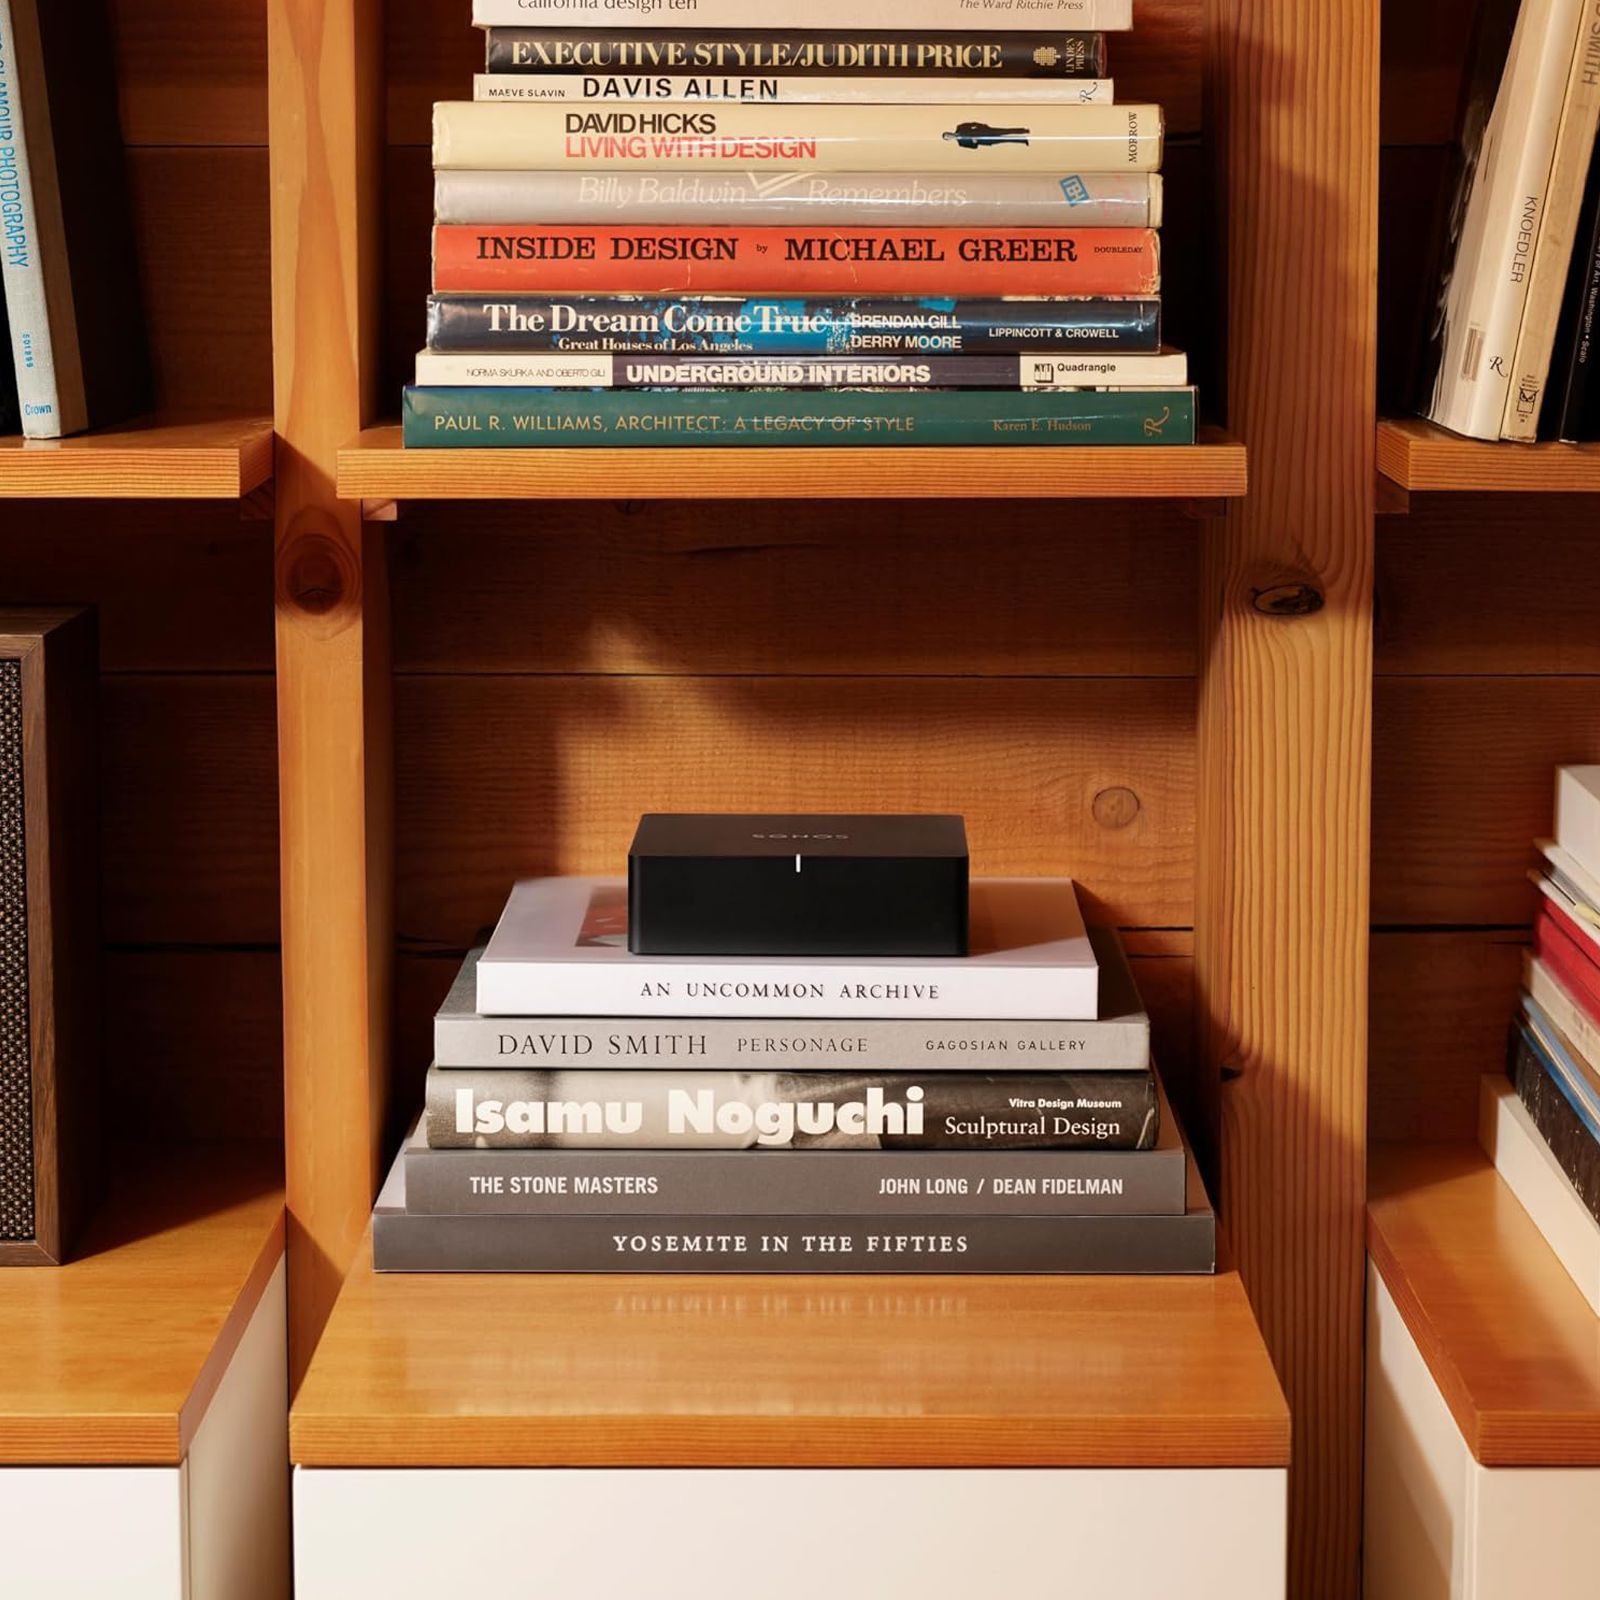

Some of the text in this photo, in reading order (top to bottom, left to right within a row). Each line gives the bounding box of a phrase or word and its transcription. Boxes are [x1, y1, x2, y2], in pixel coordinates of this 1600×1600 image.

[518, 0, 698, 13] california design ten
[960, 0, 1084, 10] The Ward Ritchie Press
[511, 41, 687, 67] EXECUTIVE
[917, 44, 1003, 69] PRICE
[1066, 38, 1075, 73] LINDEN
[1076, 40, 1085, 70] PRESS
[488, 77, 778, 100] MAEVE SLAVIN DAVIS ALLEN
[565, 113, 717, 135] DAVID HICKS
[1128, 112, 1138, 164] MORROW
[565, 136, 817, 159] LIVING WITH DESIGN
[0, 59, 29, 267] MOUR PHOTOGRAPHY
[578, 176, 968, 209] Billy Baldwin Remembers
[1510, 195, 1539, 284] KNOEDLER
[477, 237, 1078, 262] INSIDE DESIGN by MICHAEL GREER
[1093, 246, 1144, 254] DOUBLEDAY
[483, 303, 828, 334] The Dream Come True
[1584, 286, 1599, 334] Washington
[851, 315, 962, 329] BRENDAN GILL
[851, 335, 962, 349] DERRY MOORE
[989, 328, 1120, 339] LIPPINCOTT & CROWELL
[558, 337, 754, 353] Great Houses of Los Angeles
[466, 368, 498, 378] NORMA
[499, 368, 534, 378] SKURKA
[536, 368, 554, 378] AND
[555, 368, 589, 378] OBERTO
[626, 364, 931, 383] UNDERGROUND INTERIORS
[1057, 363, 1116, 374] Quadrangle
[25, 404, 52, 416] Crown
[434, 415, 915, 433] PAUL R. WILLIAMS, ARCHITECT: A LEGACY OF STYLE
[992, 418, 1092, 432] Karen E. Hudson
[640, 982, 940, 999] AN UNCOMMON ARCHIVE
[498, 1035, 1087, 1055] DAVID SMITH PERSONAGE GAGOSIAN GALLERY
[1008, 1098, 1122, 1110] Vitra Design Museum
[455, 1086, 925, 1146] Isamu Noguchi
[944, 1115, 1121, 1140] Sculptural Design
[470, 1177, 659, 1194] THE STONE MASTERS
[879, 1178, 1124, 1195] JOHN LONG / DEAN FIDELMAN
[613, 1235, 969, 1252] YOSEMITE IN THE FIFTIES
